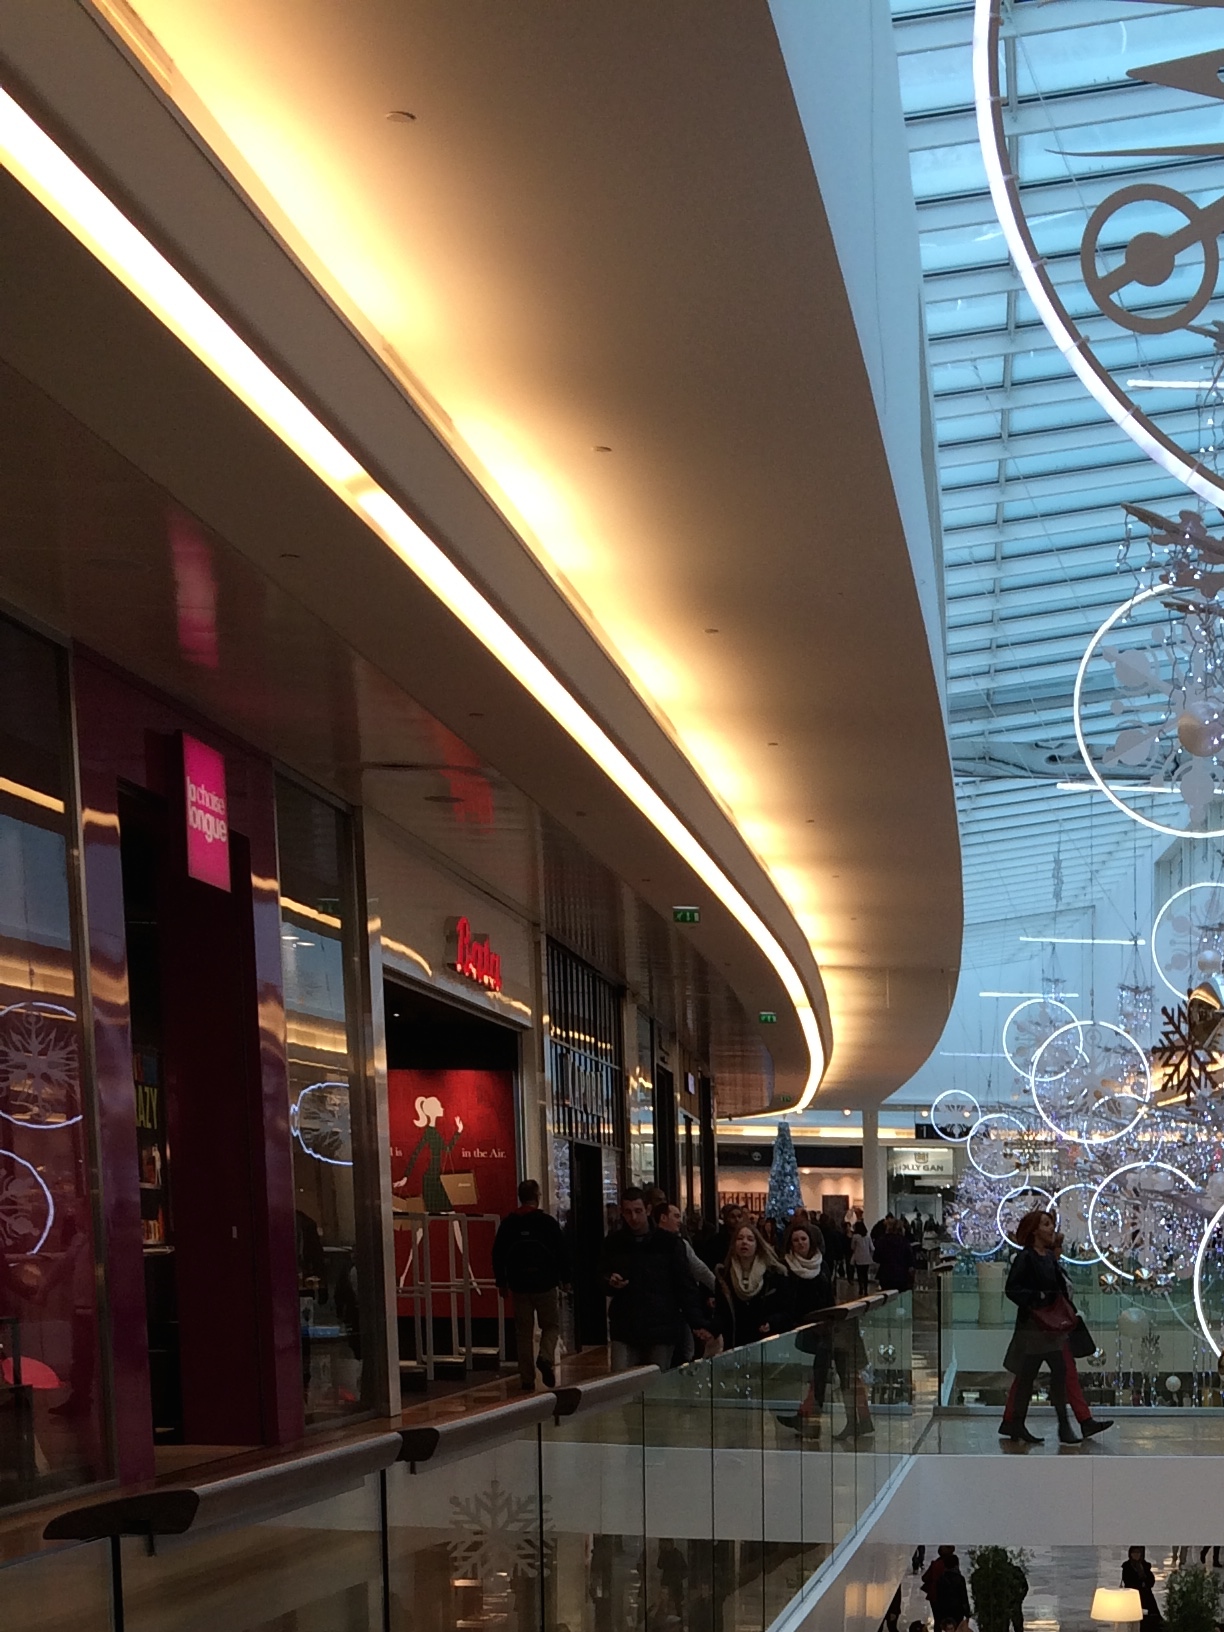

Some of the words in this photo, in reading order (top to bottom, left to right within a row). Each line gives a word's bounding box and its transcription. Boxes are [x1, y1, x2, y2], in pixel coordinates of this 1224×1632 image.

[187, 801, 227, 843] longue
[136, 1085, 158, 1130] AZY
[461, 1147, 472, 1158] in
[473, 1147, 488, 1158] the
